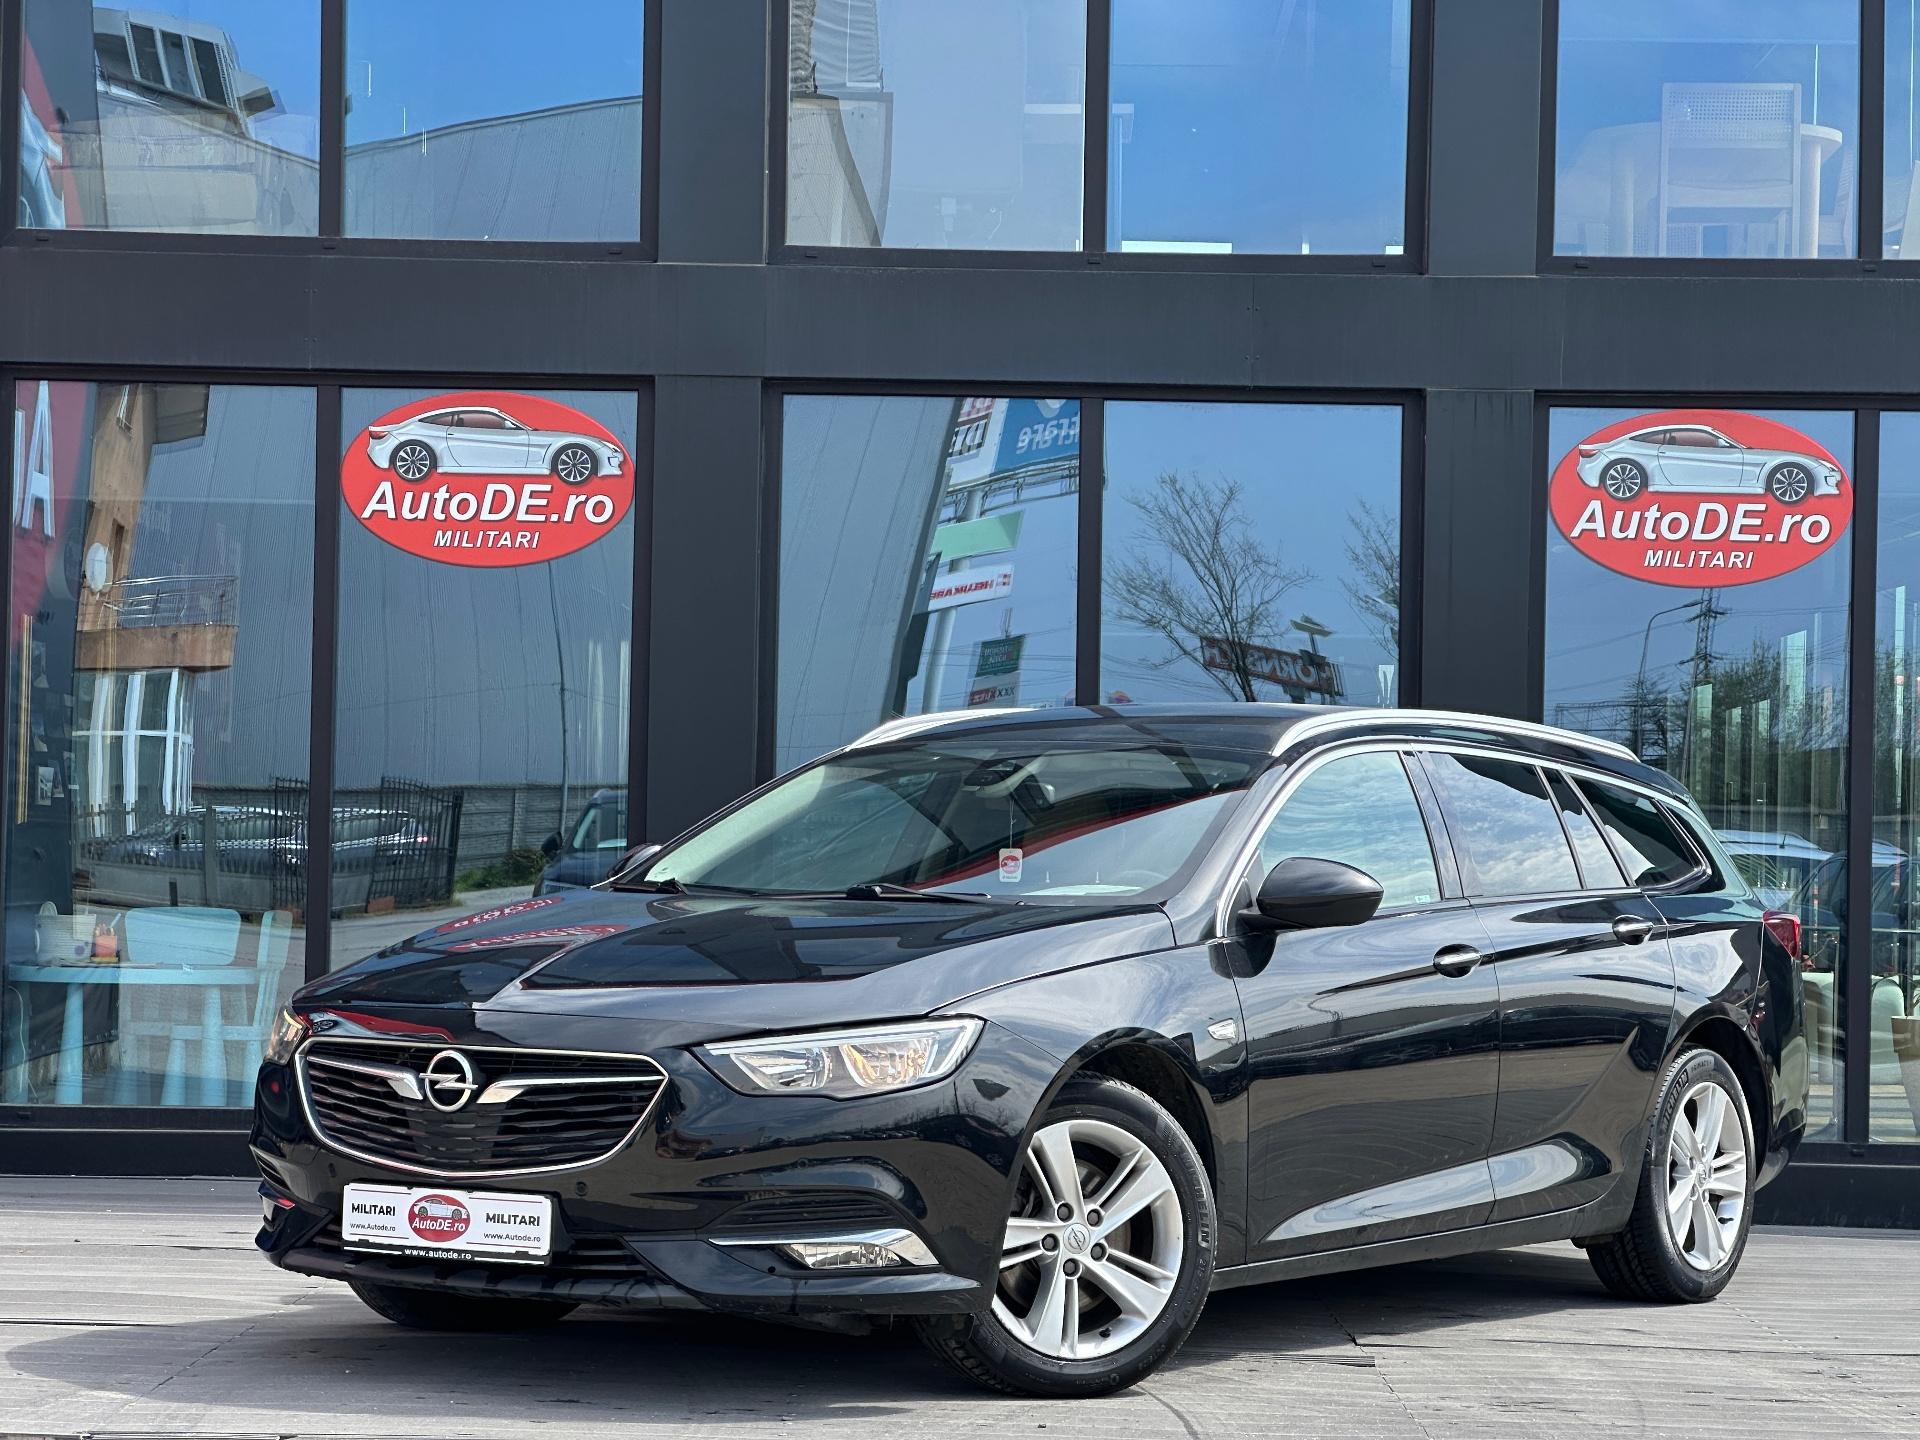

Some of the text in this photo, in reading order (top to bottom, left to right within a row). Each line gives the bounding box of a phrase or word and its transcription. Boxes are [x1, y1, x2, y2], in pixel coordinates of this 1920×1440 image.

[361, 481, 615, 524] AutoDE.ro
[1569, 500, 1832, 544] AutoDE.ro
[433, 530, 541, 549] MILITARI
[1643, 549, 1754, 569] MILITARI
[351, 1202, 396, 1217] MILITARI
[349, 1221, 396, 1232] www.Autode.ro
[411, 1217, 466, 1232] AutoDE.ro
[485, 1212, 541, 1227] MILITARI
[483, 1232, 541, 1243] www.Autode.ro
[404, 1248, 472, 1260] www.autode.ro
